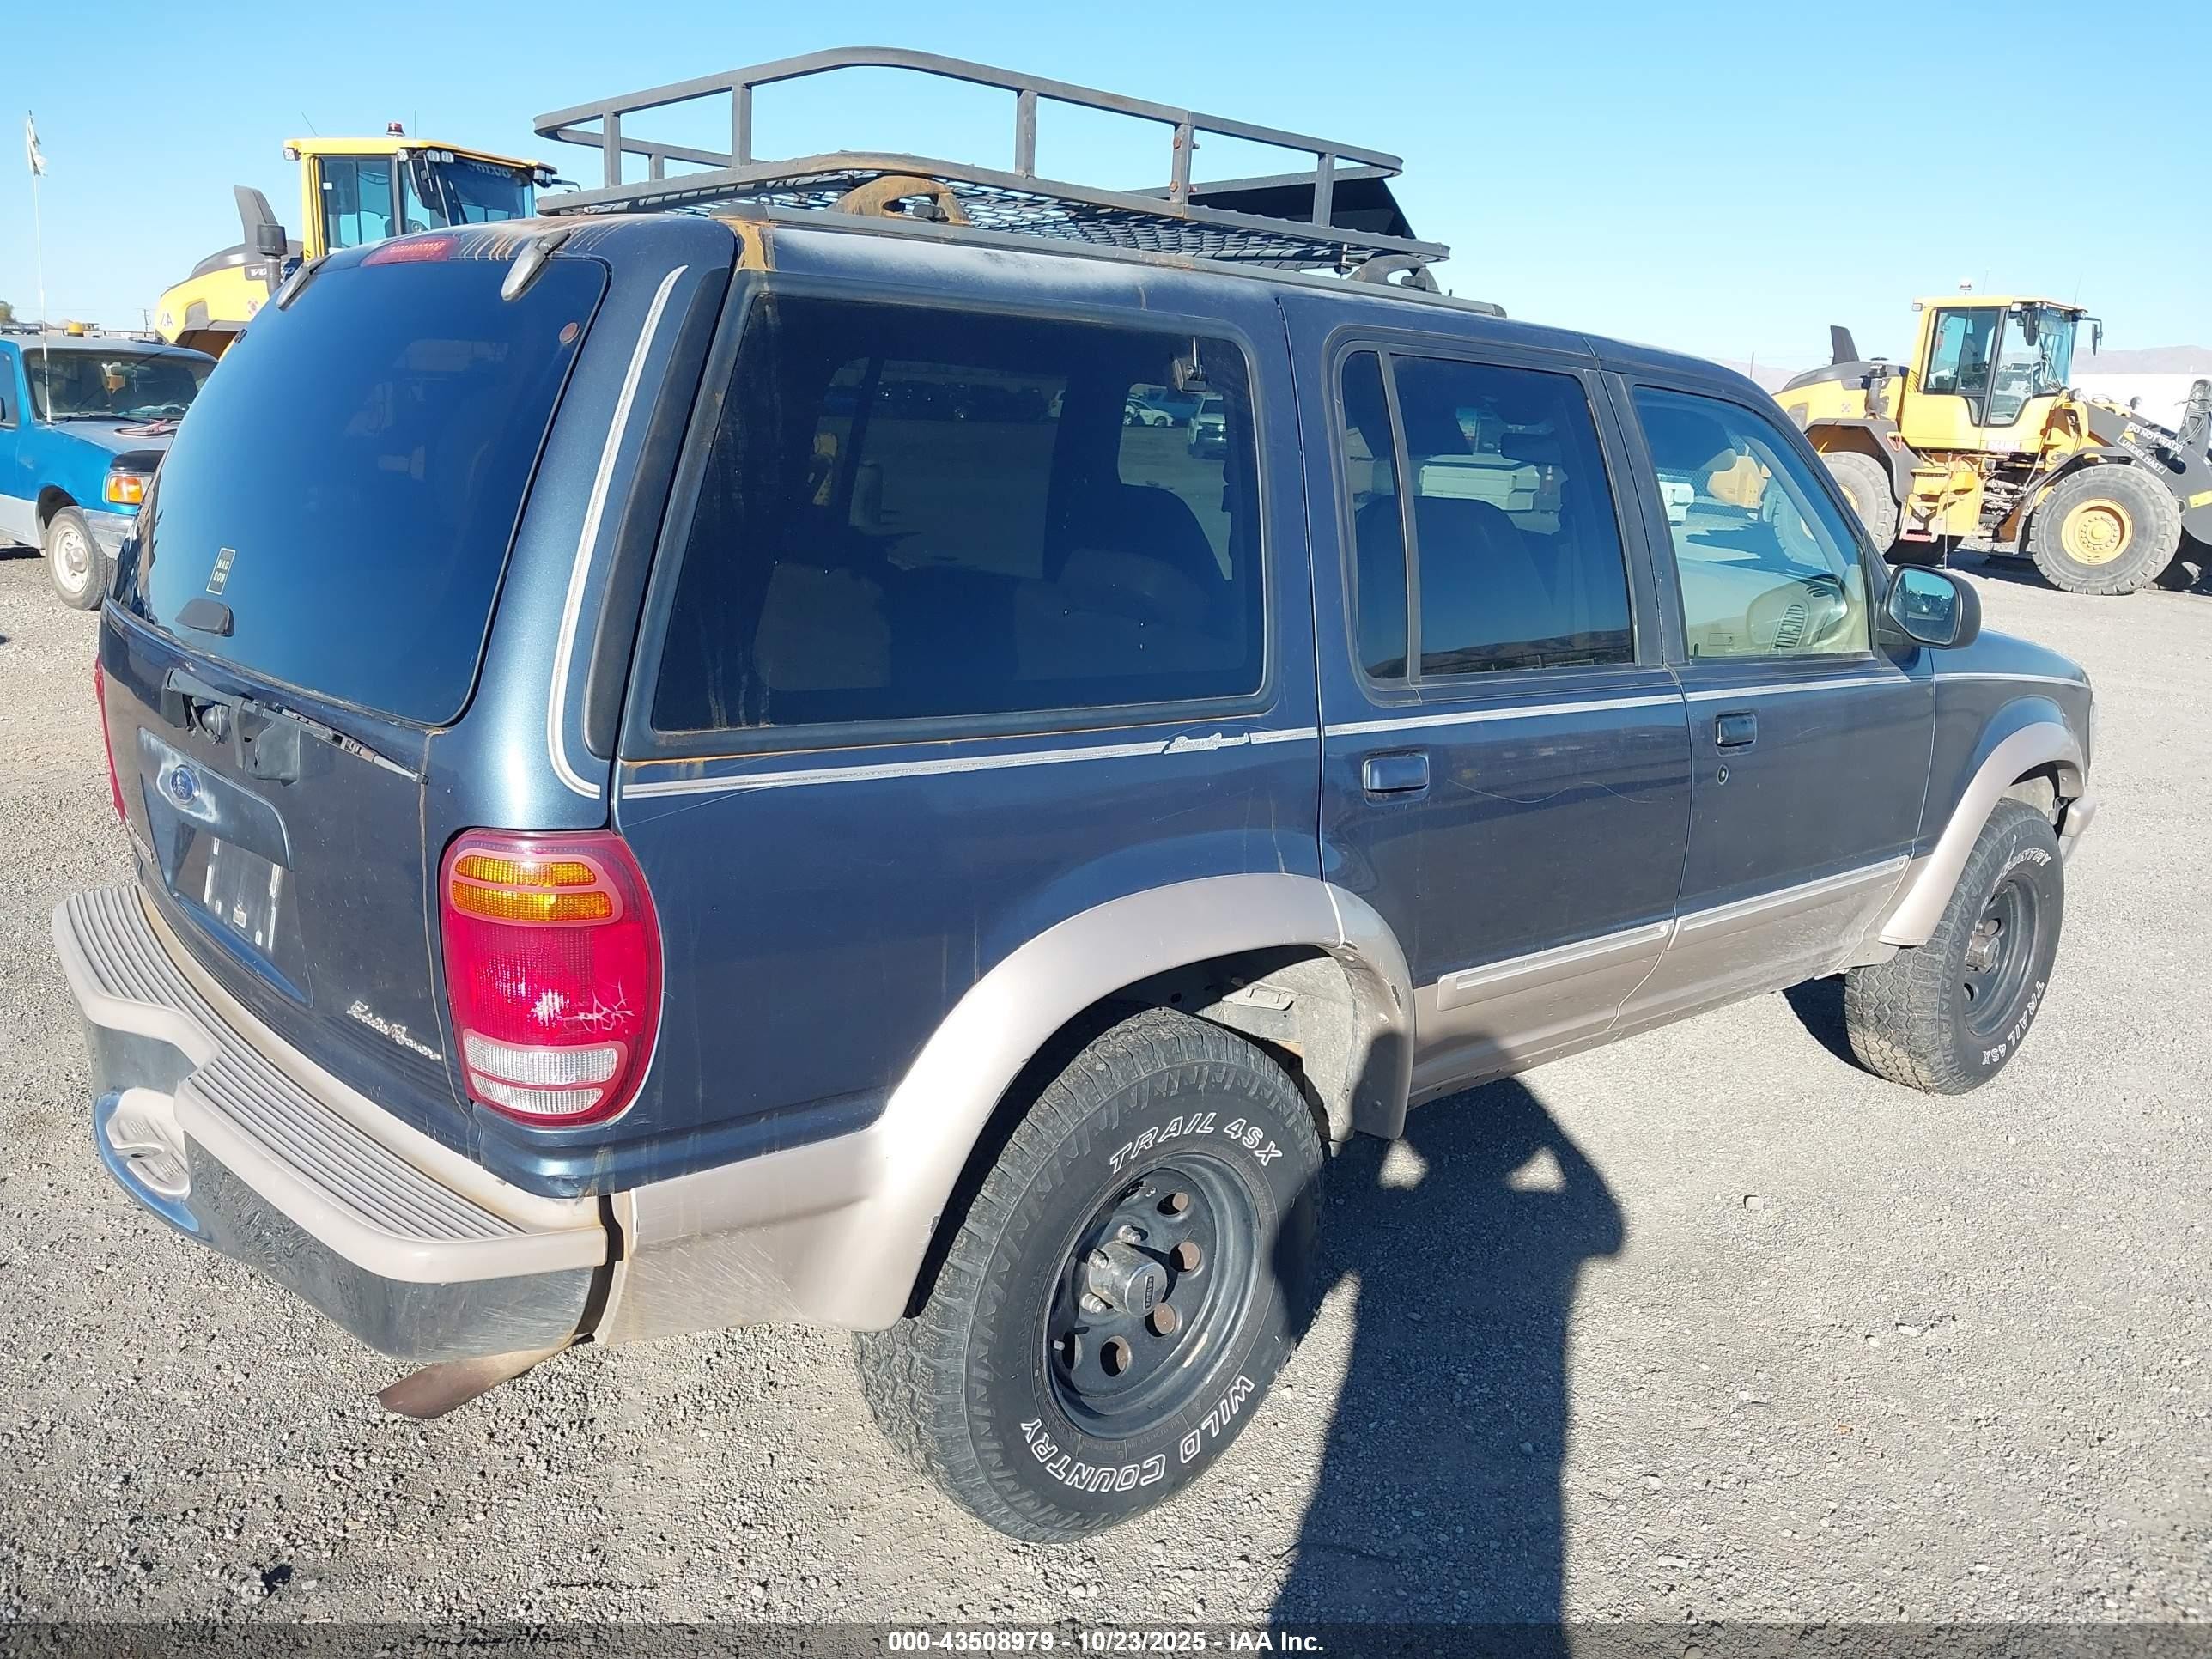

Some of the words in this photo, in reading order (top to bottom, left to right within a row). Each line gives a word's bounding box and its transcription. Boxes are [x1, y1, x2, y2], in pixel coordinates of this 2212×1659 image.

[2140, 428, 2158, 442] NOT
[2143, 453, 2164, 473] MAST
[2007, 981, 2045, 1046] TRAIL
[1982, 1043, 2007, 1066] 4SX
[1109, 1112, 1217, 1174] TRAIL
[1224, 1118, 1283, 1166] 4SX
[1180, 1374, 1255, 1464] WILD
[1020, 1418, 1166, 1492] COUNTRY
